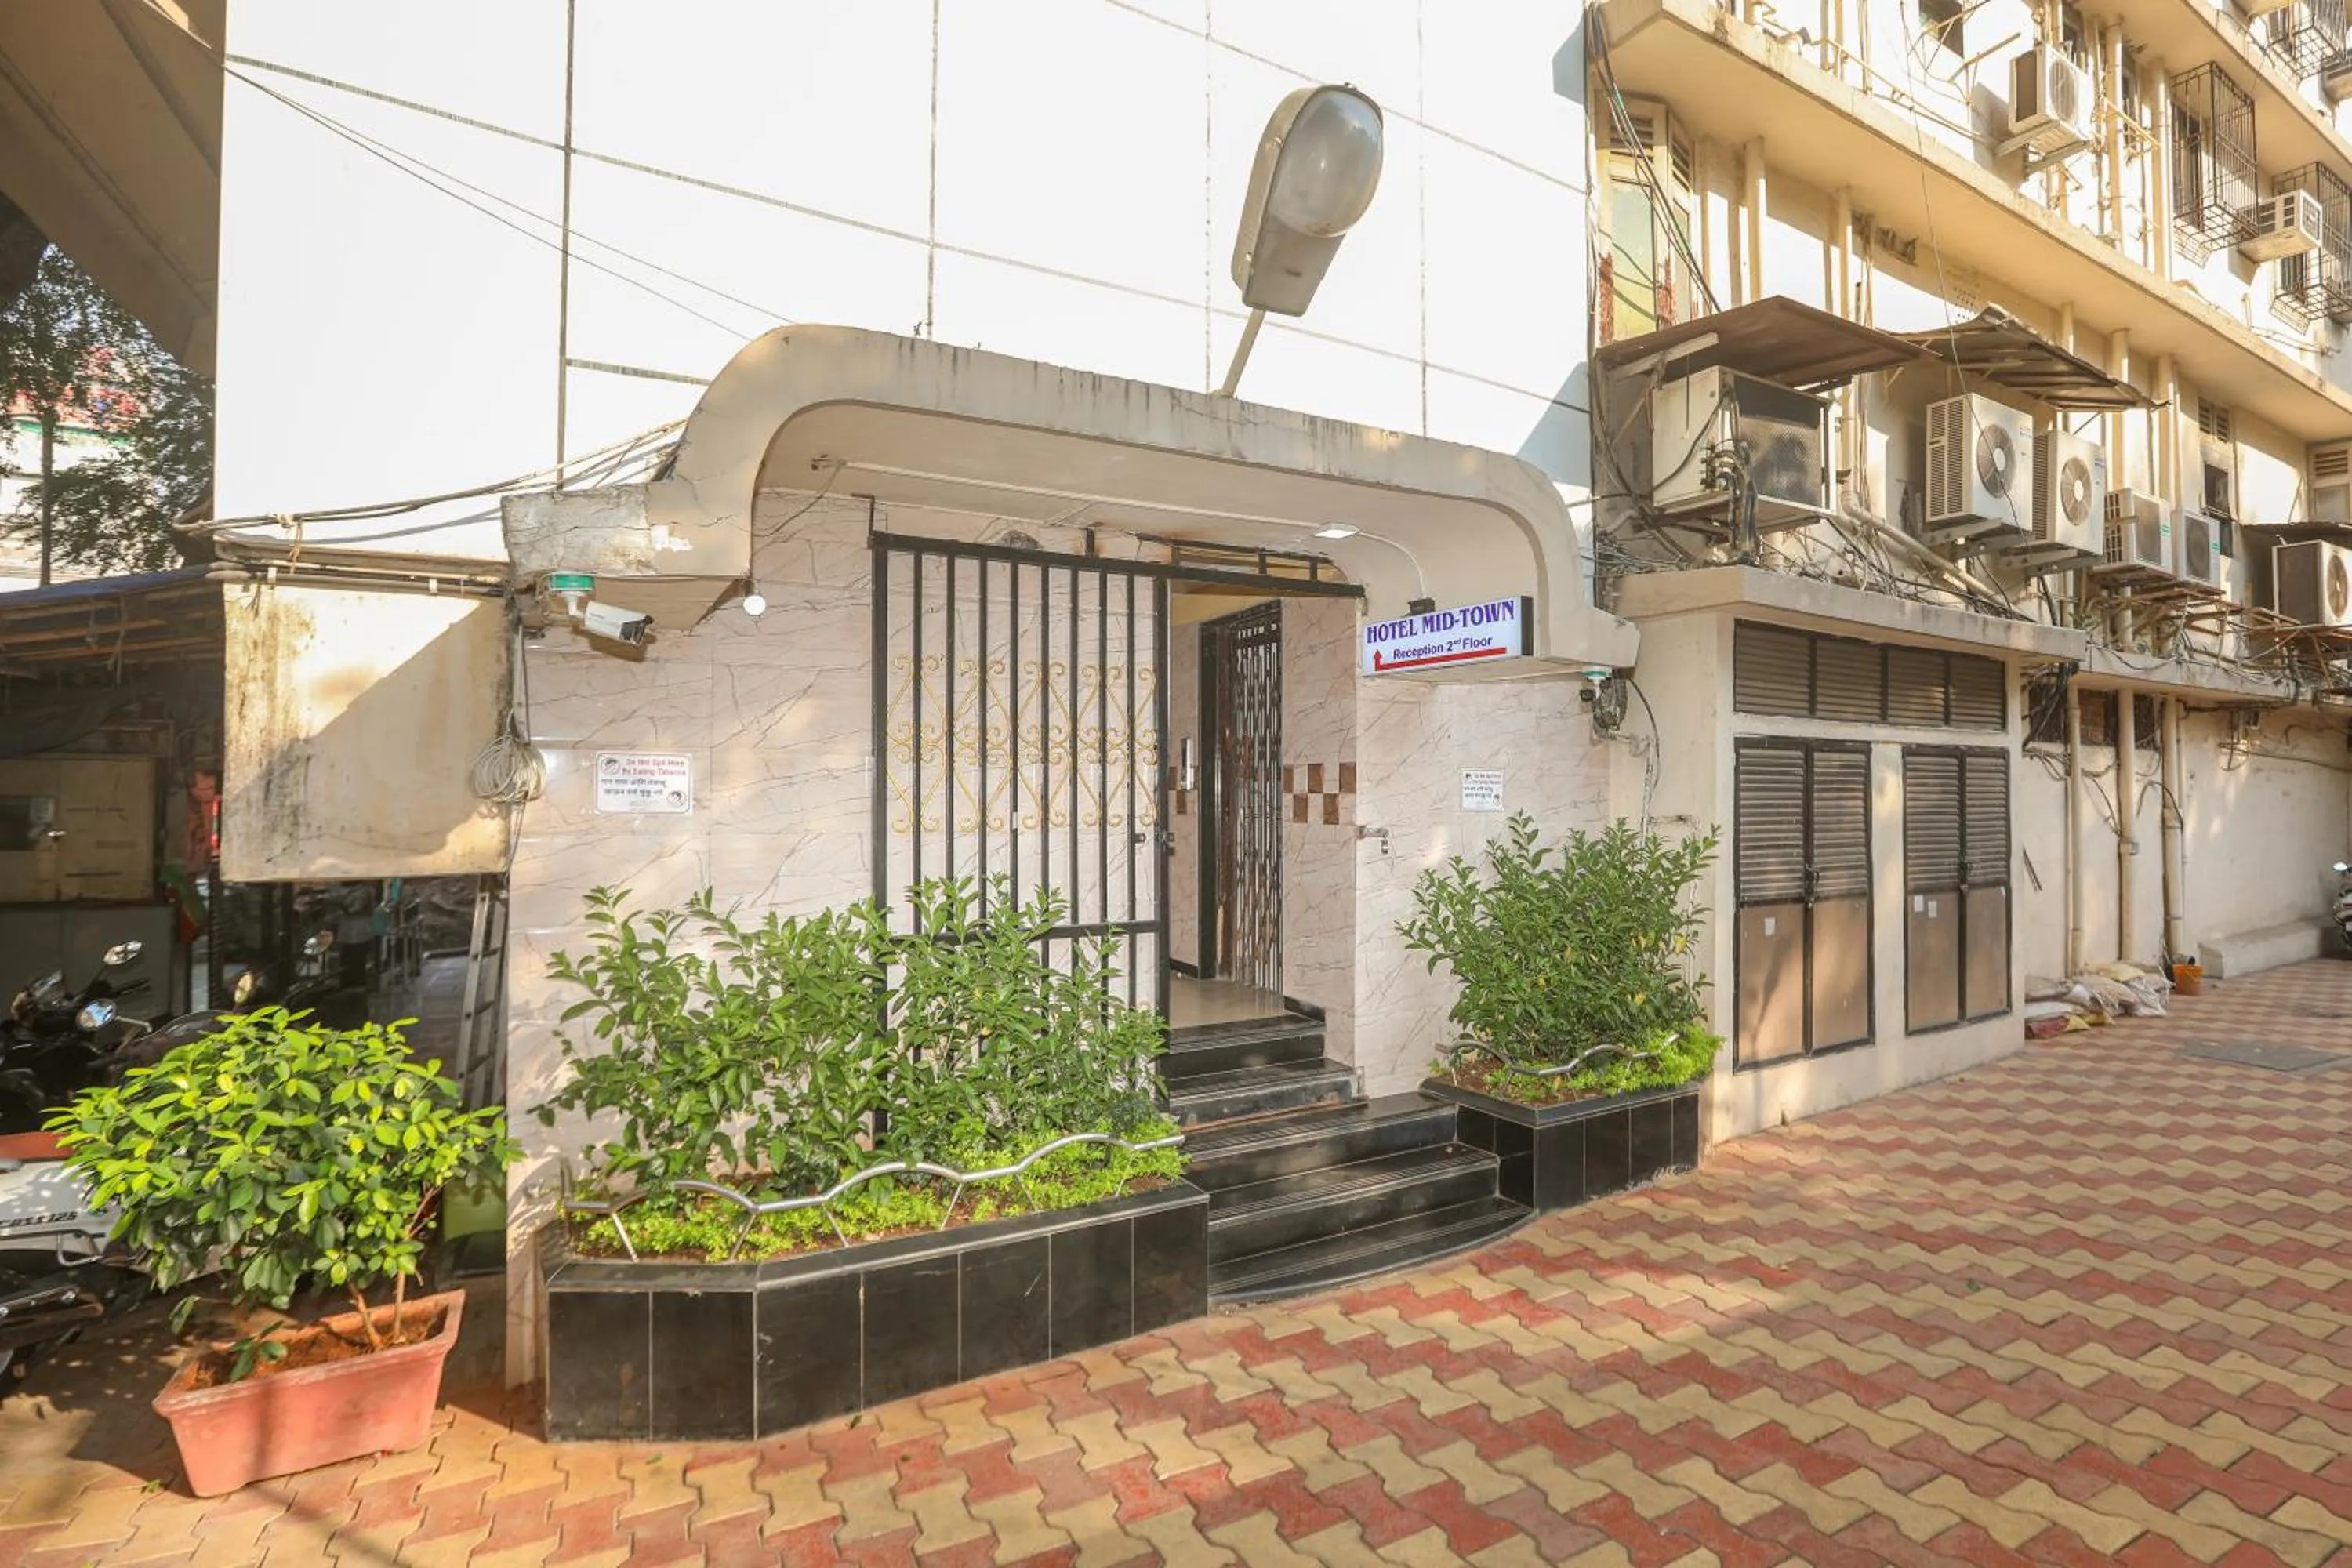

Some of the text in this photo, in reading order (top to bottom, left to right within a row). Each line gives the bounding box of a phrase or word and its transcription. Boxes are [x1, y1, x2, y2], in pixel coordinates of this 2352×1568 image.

[1367, 600, 1514, 643] HOTEL MID-TOWN
[1393, 643, 1443, 659] Reception
[1462, 637, 1492, 649] Floor
